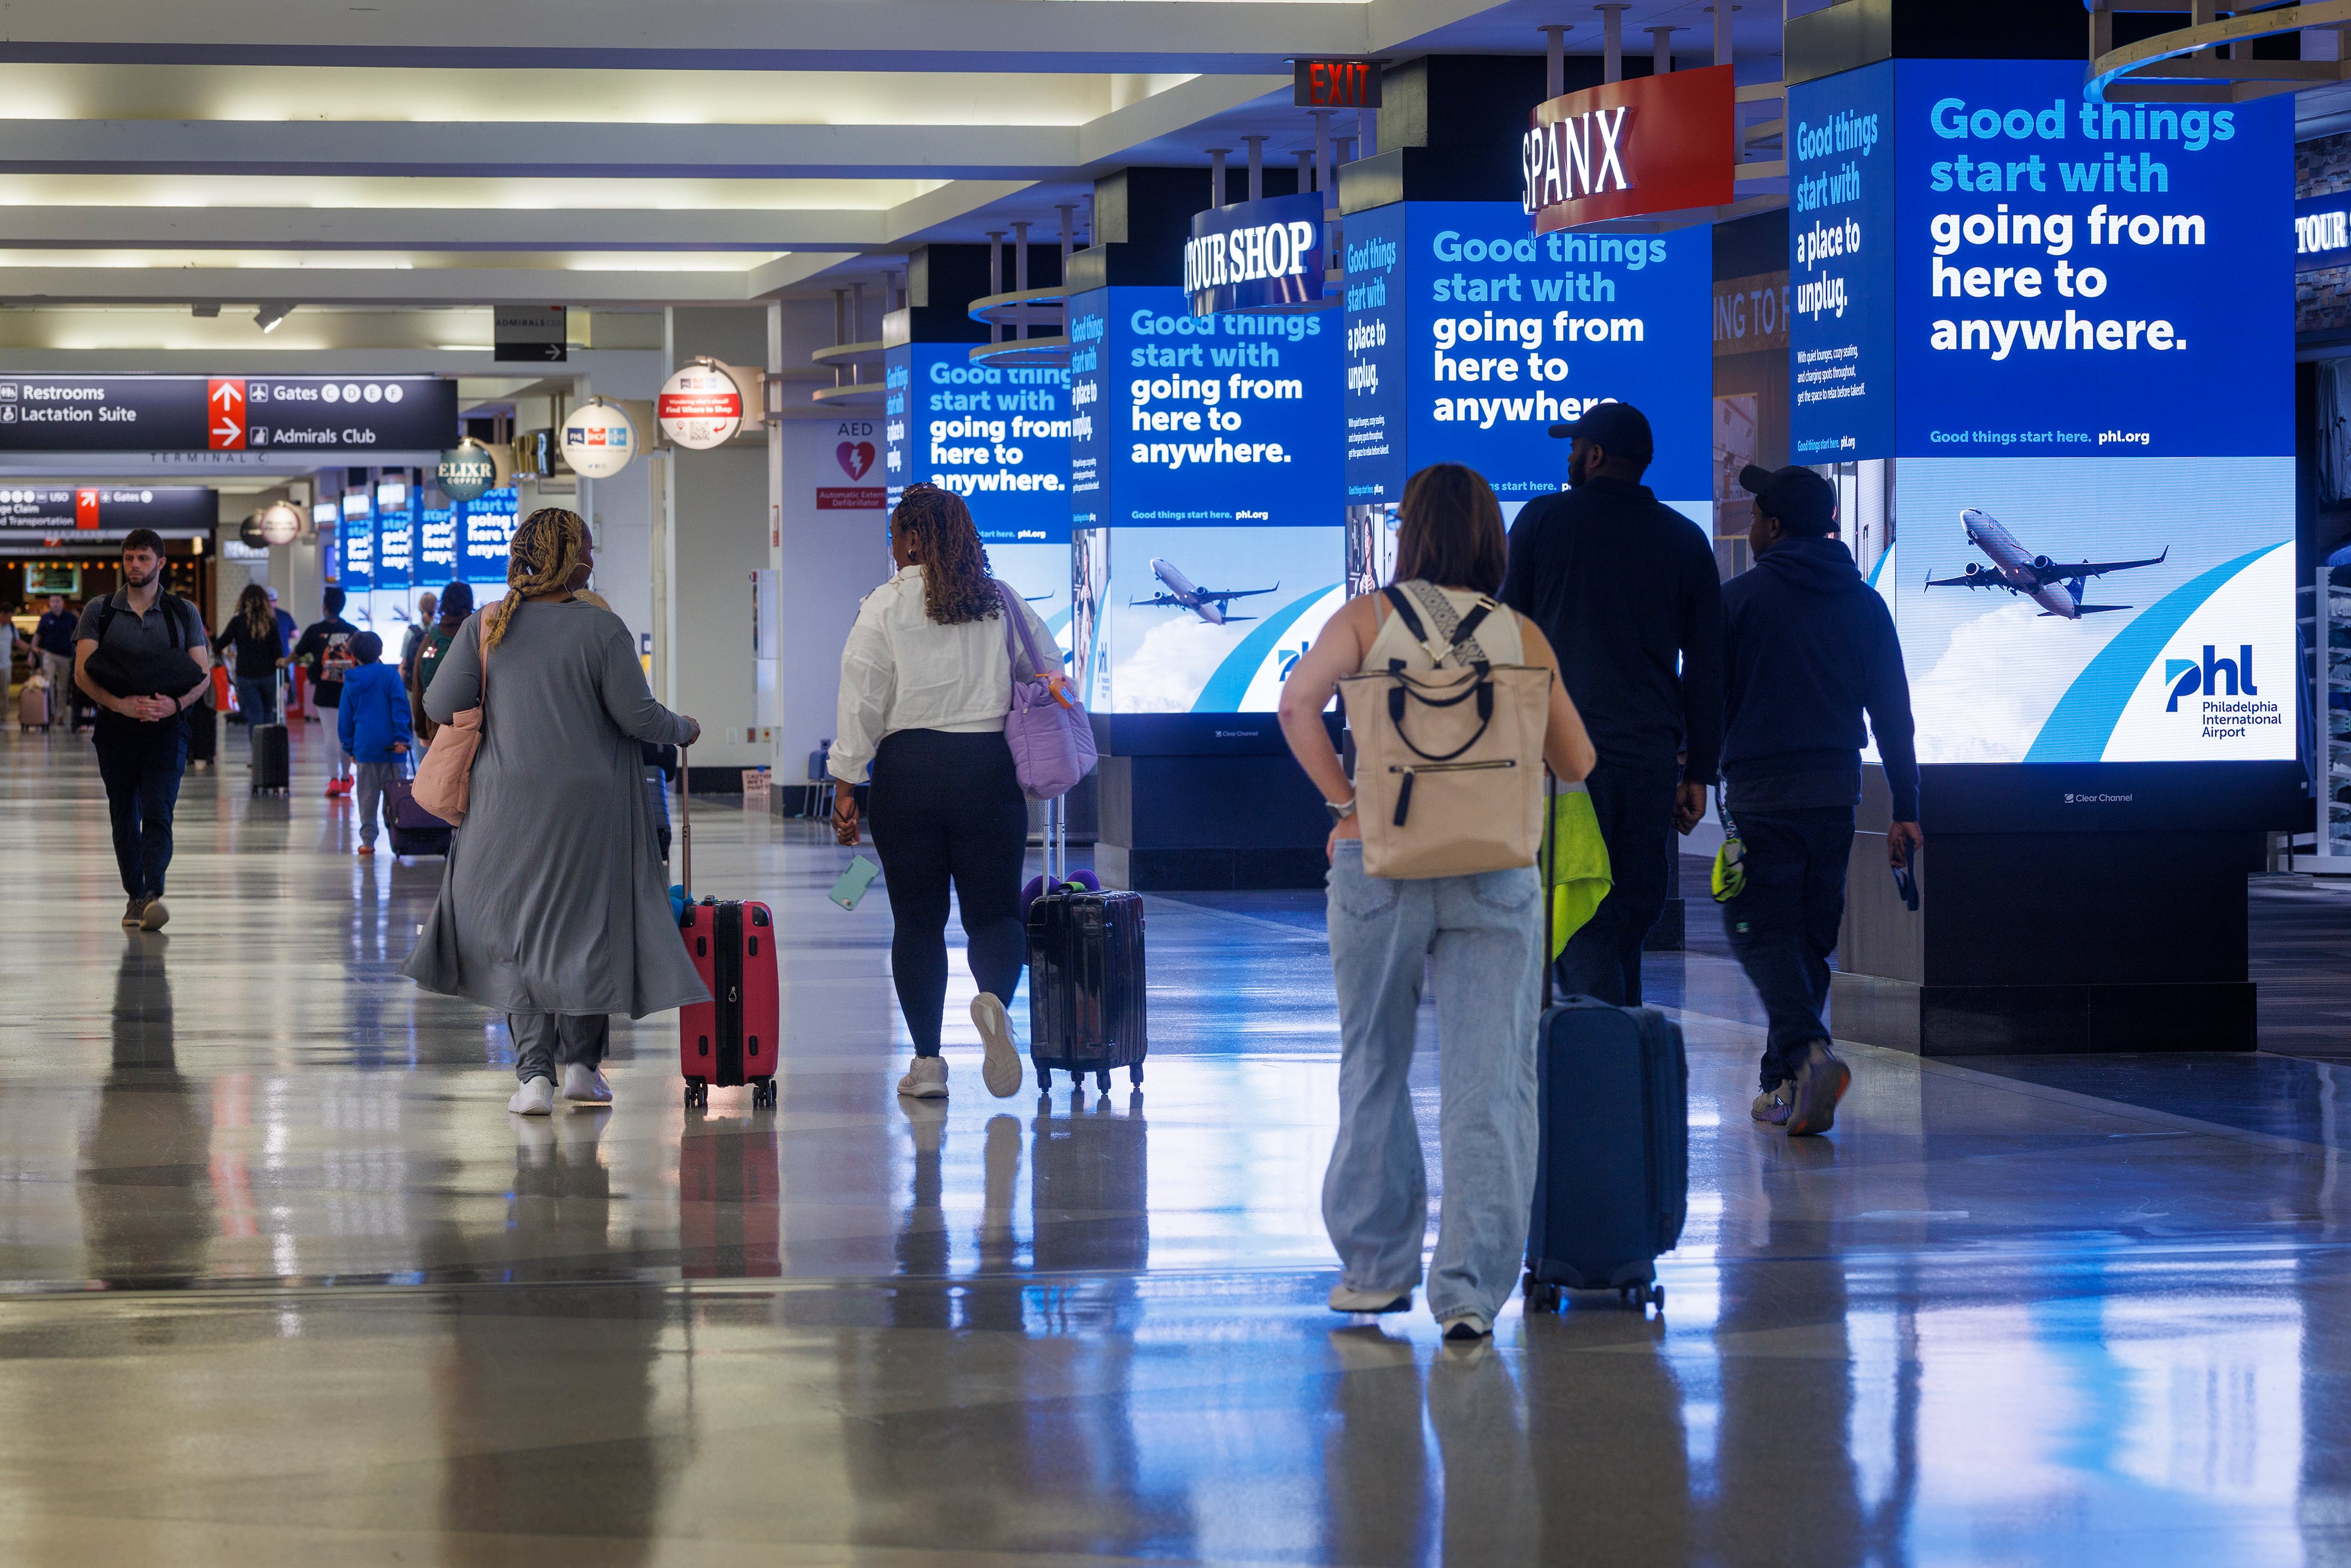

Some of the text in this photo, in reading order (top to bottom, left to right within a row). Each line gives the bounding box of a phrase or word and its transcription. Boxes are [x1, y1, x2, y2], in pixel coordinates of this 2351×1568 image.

[1310, 64, 1370, 104] EXIT
[1797, 109, 1877, 161] Good things
[1931, 98, 2235, 151] Good things
[1523, 106, 1628, 215] SPANX
[1930, 153, 2168, 193] start with
[1797, 161, 1860, 213] start with
[1930, 204, 2206, 255] going from
[2295, 211, 2349, 253] TOUR
[1188, 233, 1227, 291] TOUR
[1230, 221, 1313, 283] SHOP
[1348, 237, 1396, 274] Good things
[1434, 231, 1666, 271] Good things
[1798, 217, 1860, 271] a place to
[1433, 271, 1615, 301] start with
[1932, 257, 2107, 298] here to
[1348, 276, 1385, 313] start with
[1798, 270, 1847, 321] unplug.
[1131, 309, 1321, 341] Good things
[1751, 288, 1775, 335] TO
[1072, 313, 1104, 344] Good things
[1348, 318, 1386, 358] a place to
[1433, 310, 1644, 350] going from
[1930, 310, 2186, 361] anywhere.
[1072, 345, 1097, 374] start with
[1131, 342, 1279, 367] start with
[1434, 350, 1569, 381] here to
[1798, 351, 1806, 364] With
[1807, 350, 1816, 365] quiet
[1817, 349, 1833, 363] lounges,
[1833, 348, 1843, 361] cozy
[1131, 373, 1302, 405] going from
[1348, 357, 1378, 396] unplug.
[1805, 369, 1822, 384] charging
[1822, 368, 1833, 382] spots
[23, 385, 105, 400] Restrooms
[274, 385, 318, 400] Gates
[930, 389, 1054, 411] start with
[1076, 379, 1091, 411] place
[1091, 379, 1097, 402] to
[1811, 391, 1822, 404] space
[1822, 389, 1827, 399] to
[1827, 386, 1837, 399] relax
[1837, 385, 1849, 398] before
[21, 406, 136, 421] Lactation Suite
[714, 406, 732, 414] Shop
[1132, 405, 1241, 431] here to
[1434, 390, 1619, 429] anywher
[273, 429, 376, 443] Admirals Club
[838, 423, 872, 436] AED
[930, 415, 1005, 443] going
[1012, 415, 1071, 437] from
[1930, 430, 2150, 447] Good things start here. phl.org
[151, 452, 246, 463] TERMINAL
[931, 442, 1023, 465] here to
[1131, 438, 1291, 469] anywhere.
[1798, 440, 1808, 452] Good
[1808, 439, 1820, 453] things
[1821, 438, 1829, 450] start
[1840, 435, 1855, 450] phl.org
[438, 463, 492, 477] ELIXR
[447, 476, 483, 485] COFFEE
[931, 469, 1065, 496] anywhere.
[49, 491, 140, 503] USO Gates
[1502, 482, 1527, 490] start
[1530, 482, 1556, 490] here.
[9, 516, 74, 526] Transportation
[14, 504, 39, 514] Claim
[467, 512, 511, 531] going
[1131, 511, 1156, 519] Good
[1157, 511, 1186, 521] things
[1210, 511, 1232, 519] here.
[1236, 510, 1268, 521] phl.org
[1018, 529, 1046, 540] phl.org
[2165, 644, 2257, 712] phl
[2203, 701, 2277, 714] Philadelphia
[2203, 714, 2282, 725] International
[2202, 726, 2246, 740] Airport
[2098, 793, 2132, 802] Channel
